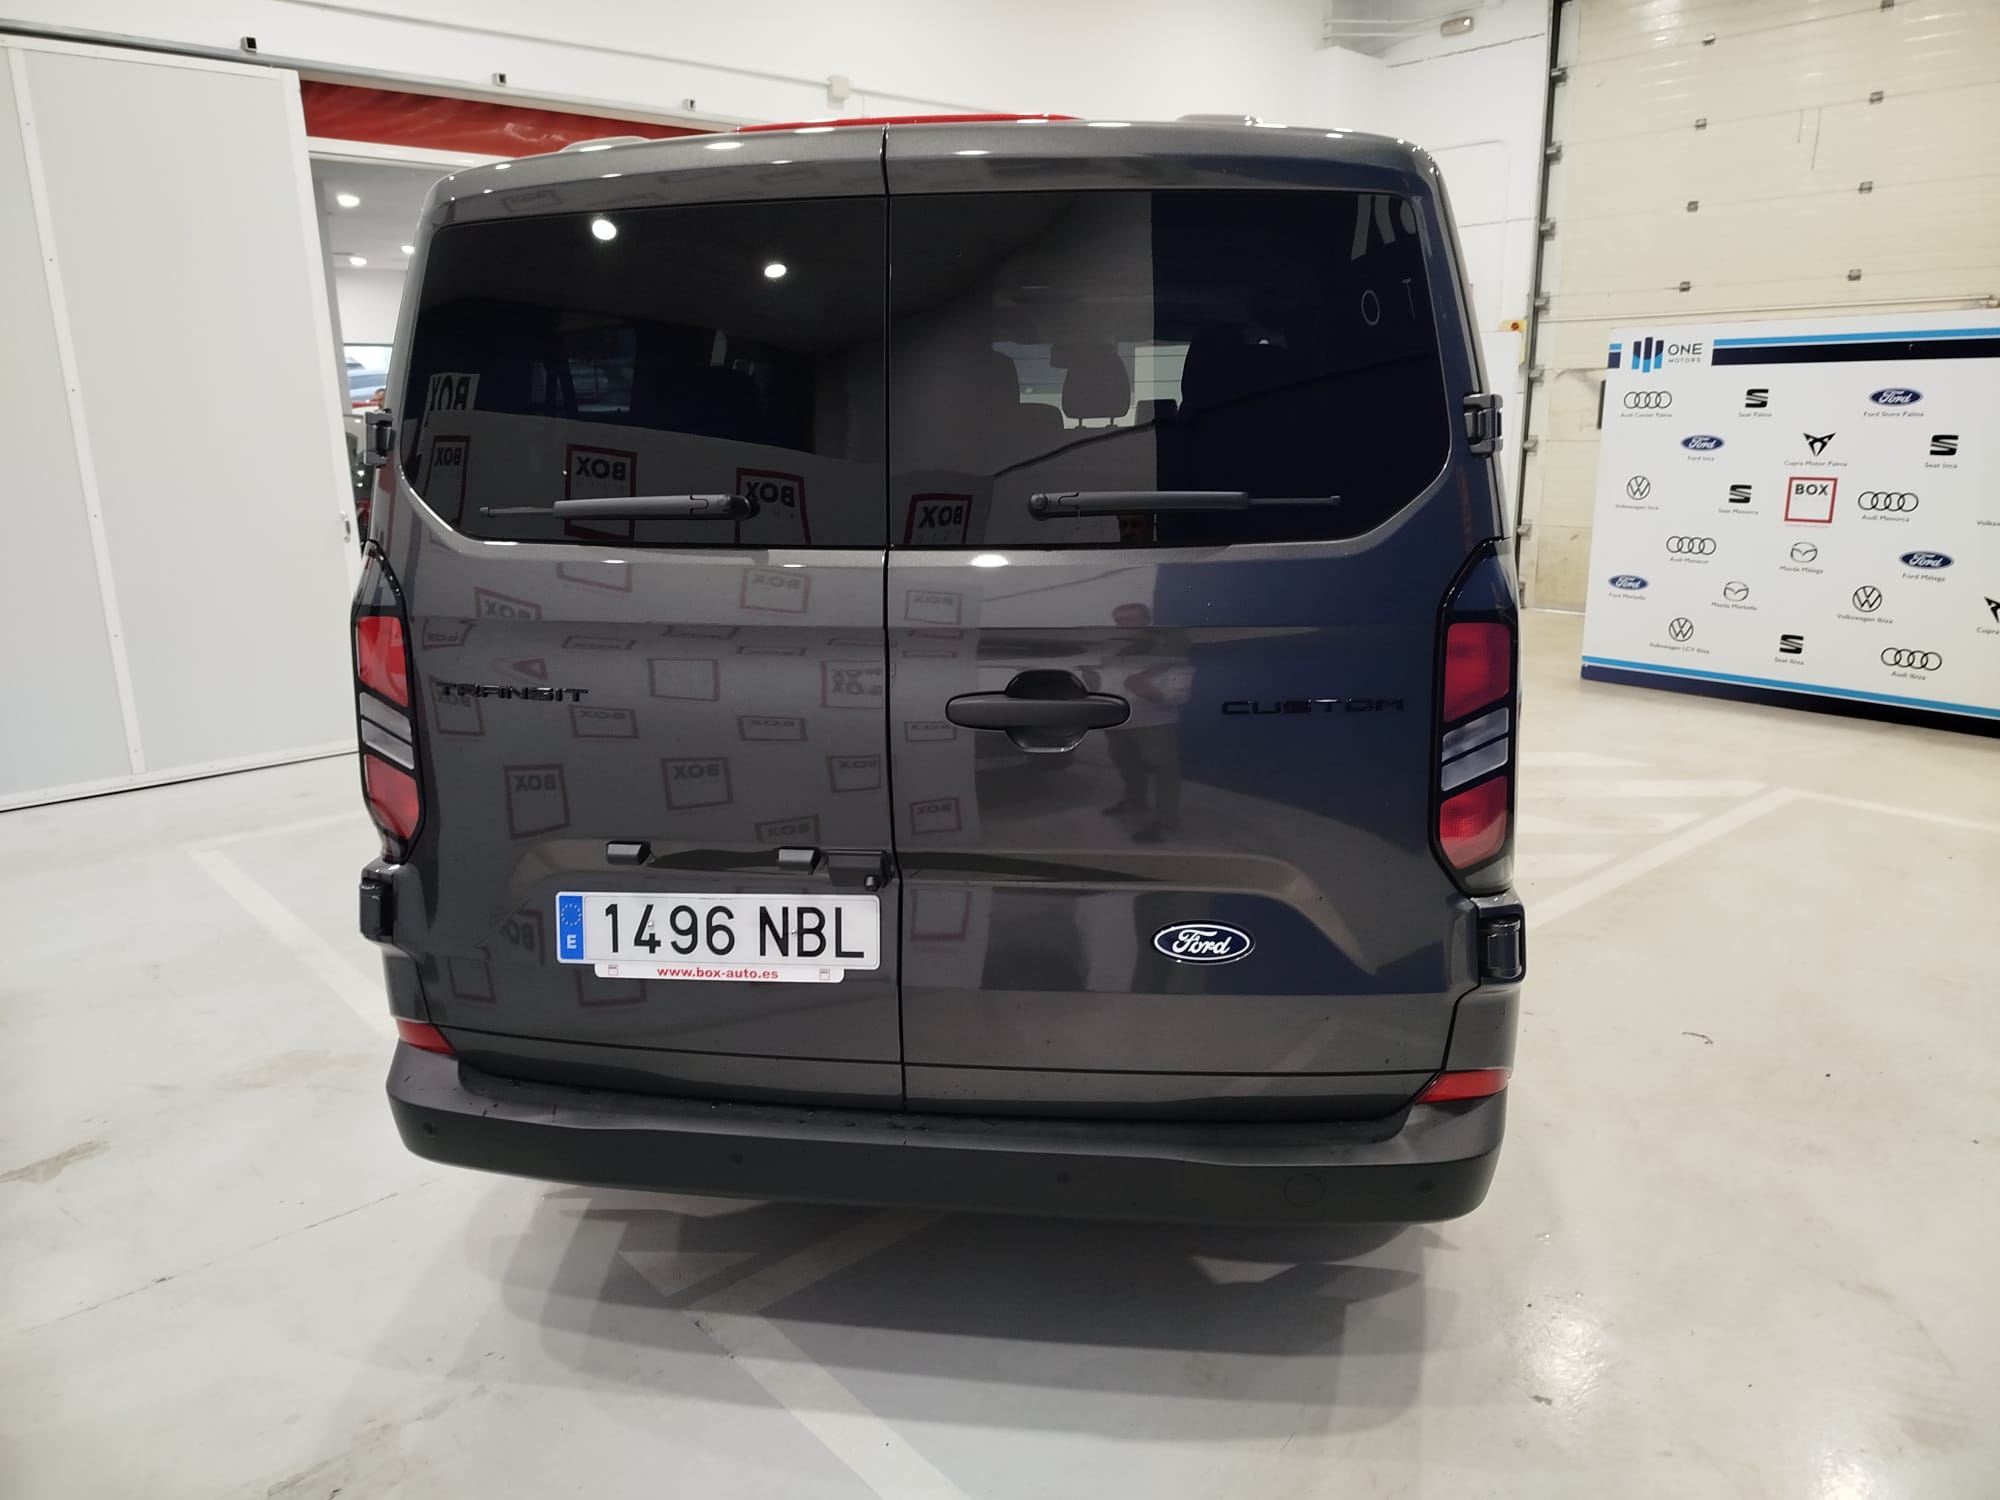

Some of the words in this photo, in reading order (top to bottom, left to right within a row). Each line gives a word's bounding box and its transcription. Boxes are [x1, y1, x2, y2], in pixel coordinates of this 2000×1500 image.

[1668, 343, 1703, 356] ONE
[1879, 390, 1914, 405] Ford
[1794, 484, 1830, 496] BOX
[1909, 553, 1943, 568] Ford
[1902, 572, 1919, 581] Ford
[1976, 626, 2000, 636] Cupra
[1891, 670, 1908, 679] Audi
[436, 682, 589, 702] TRANSIT
[1221, 699, 1405, 715] CUSTOM
[605, 904, 735, 956] 1496
[759, 906, 865, 959] NBL
[567, 934, 577, 950] E
[1172, 929, 1232, 955] Ford
[656, 967, 779, 979] www.box-auto.es
